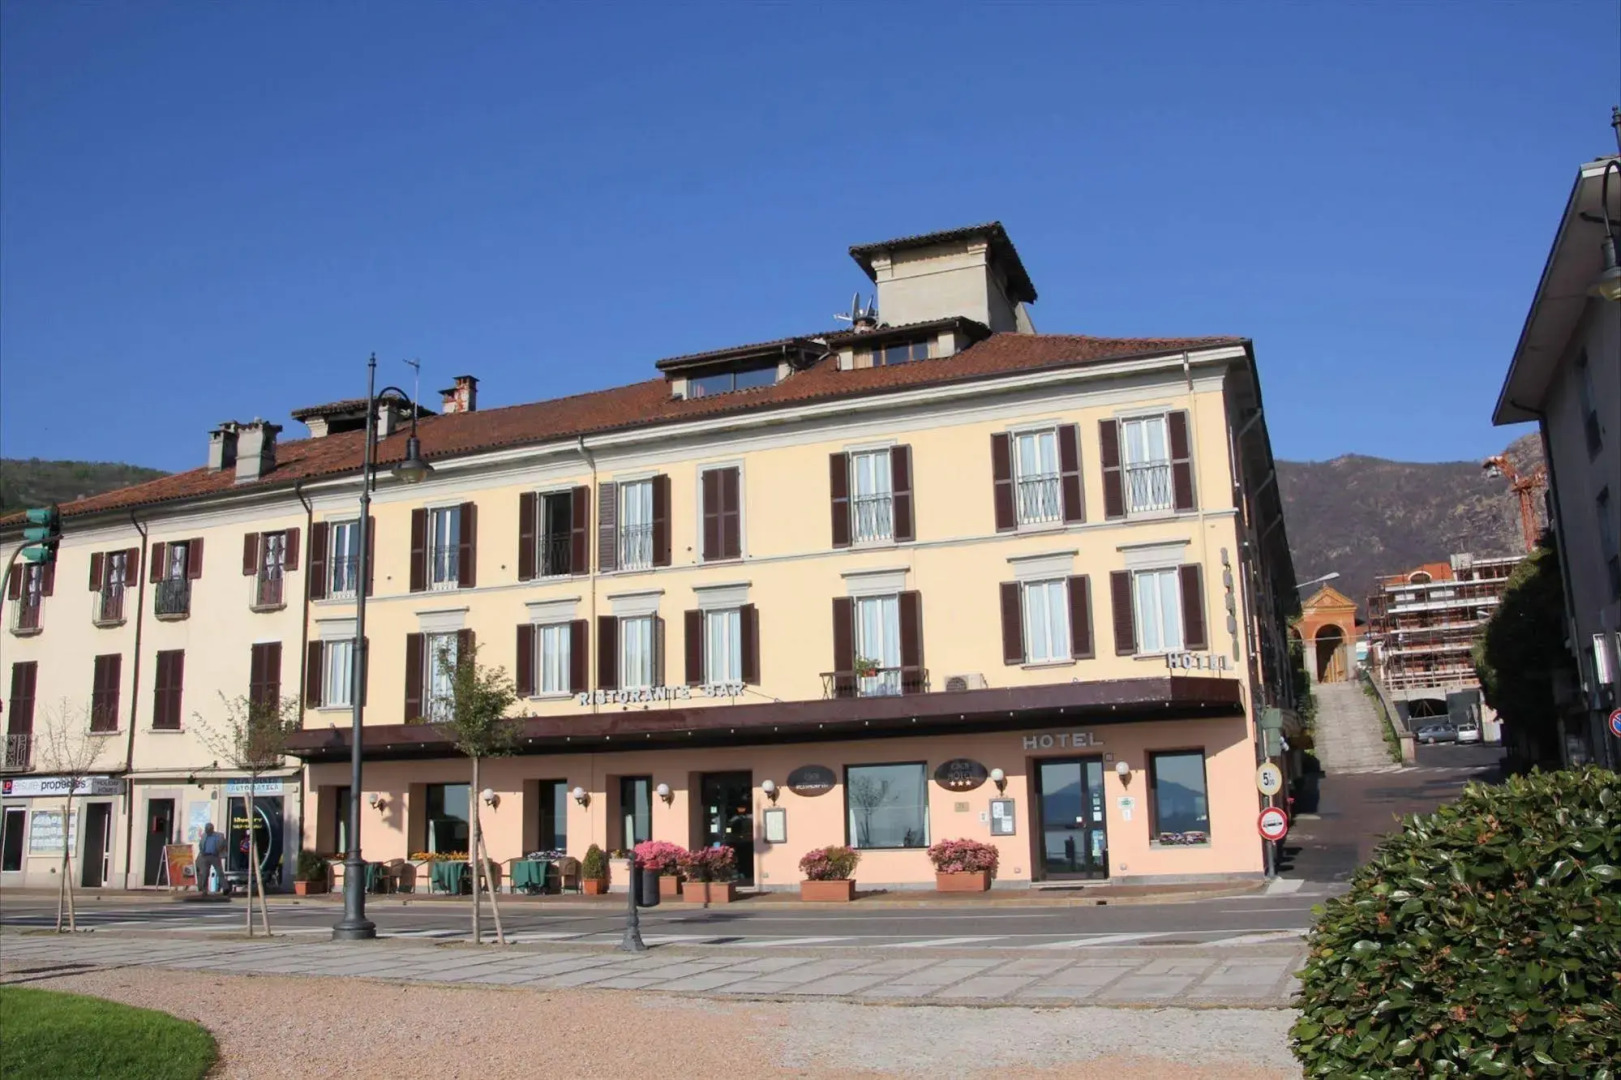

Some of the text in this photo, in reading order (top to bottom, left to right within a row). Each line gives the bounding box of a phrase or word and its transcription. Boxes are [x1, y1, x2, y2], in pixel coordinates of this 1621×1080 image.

[1166, 653, 1234, 670] HOTEL
[579, 680, 745, 706] RISTORANTE BAR
[1022, 732, 1104, 750] HOTEL
[1263, 772, 1269, 786] 5
